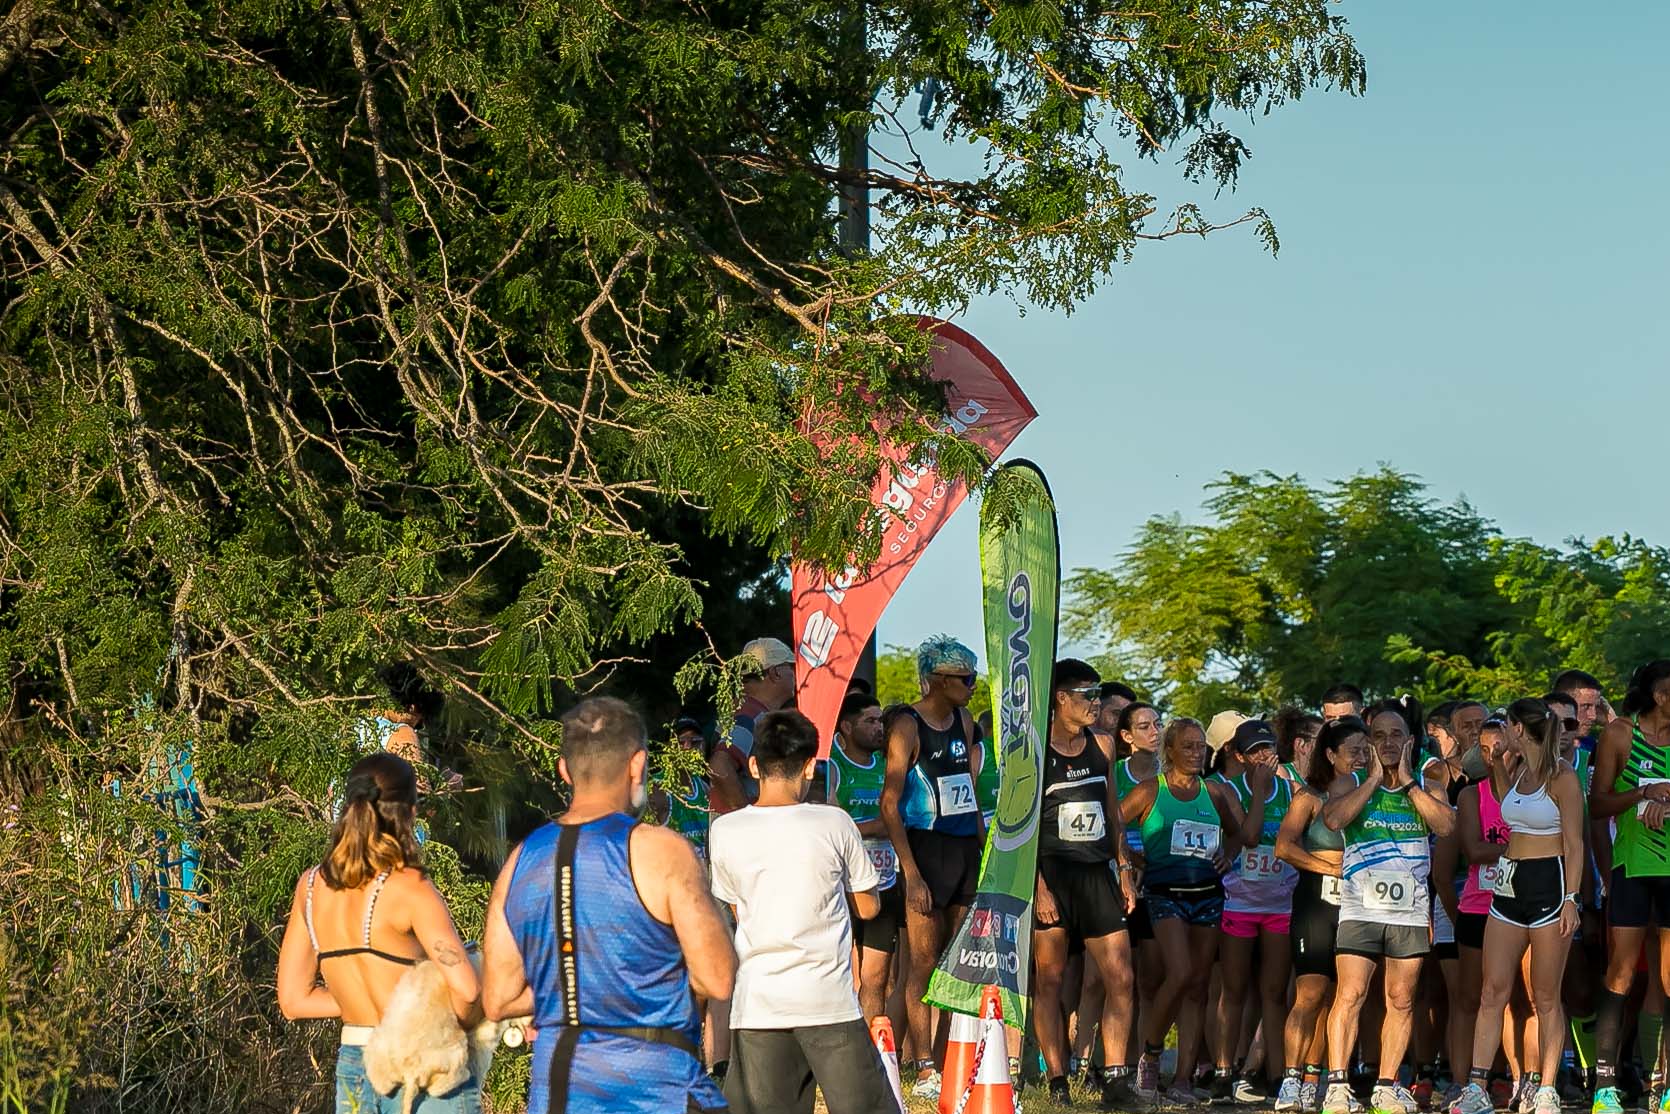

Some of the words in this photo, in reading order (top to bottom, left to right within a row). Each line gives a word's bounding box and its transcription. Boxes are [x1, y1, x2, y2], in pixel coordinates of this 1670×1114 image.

[890, 477, 951, 555] SEGURO
[952, 784, 972, 805] 72
[1071, 813, 1097, 832] 47
[1184, 831, 1207, 849] 11
[1246, 853, 1282, 873] 516
[1375, 881, 1404, 901] 90
